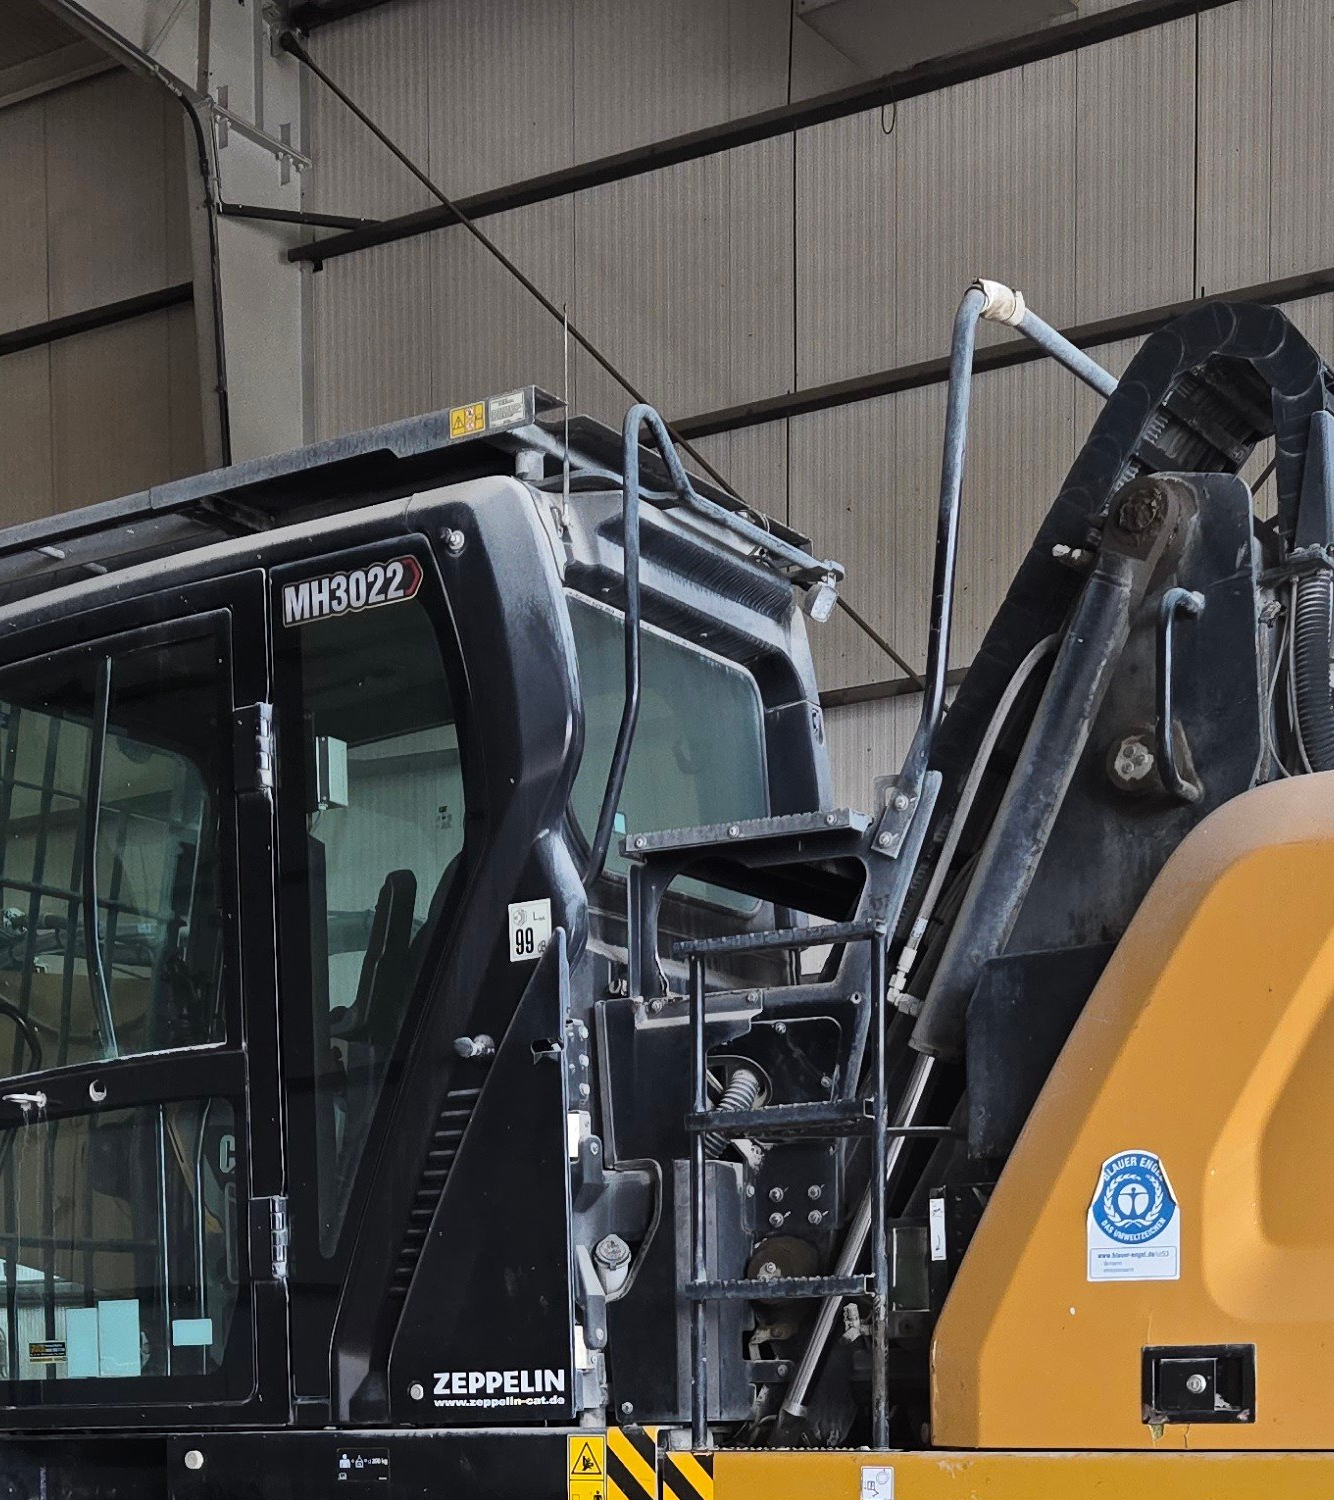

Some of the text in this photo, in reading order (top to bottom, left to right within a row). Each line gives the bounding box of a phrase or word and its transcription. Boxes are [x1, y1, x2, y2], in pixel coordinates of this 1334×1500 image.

[284, 561, 405, 624] MH3022
[516, 927, 534, 955] 99
[1100, 1219, 1115, 1234] DAS
[433, 1369, 565, 1394] ZEPPELIN
[433, 1394, 566, 1409] www.zeppelin-cat.de
